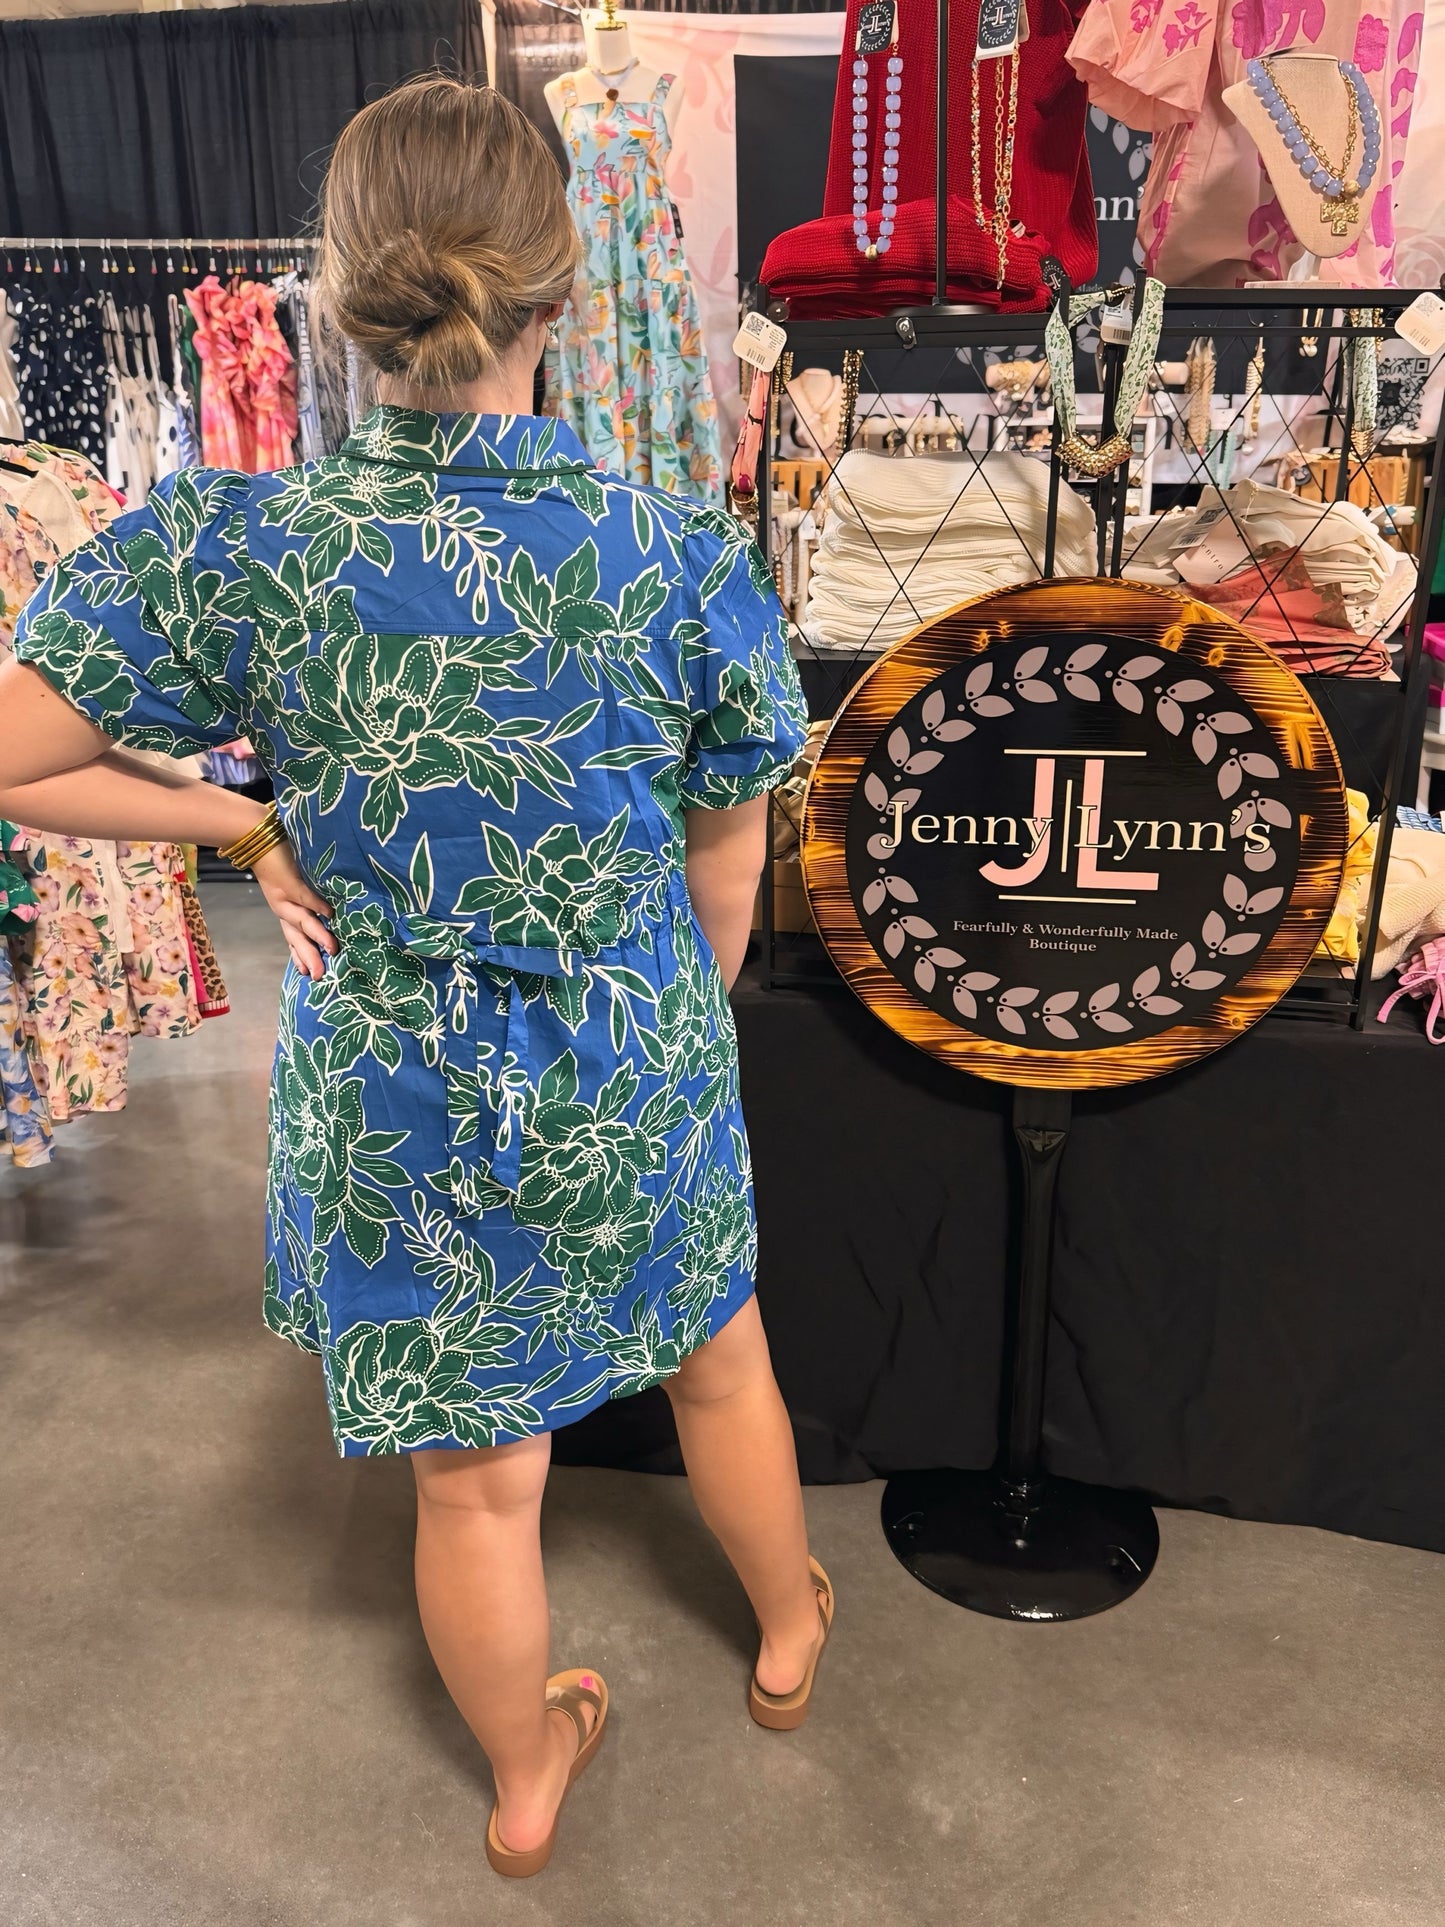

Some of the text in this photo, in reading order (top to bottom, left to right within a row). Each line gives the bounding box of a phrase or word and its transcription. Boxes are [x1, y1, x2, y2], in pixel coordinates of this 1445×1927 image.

[880, 800, 1271, 861] Jenny Lynn's
[952, 920, 1179, 941] Fearfully & Wonderfully Made
[1028, 938, 1097, 954] Boutique
